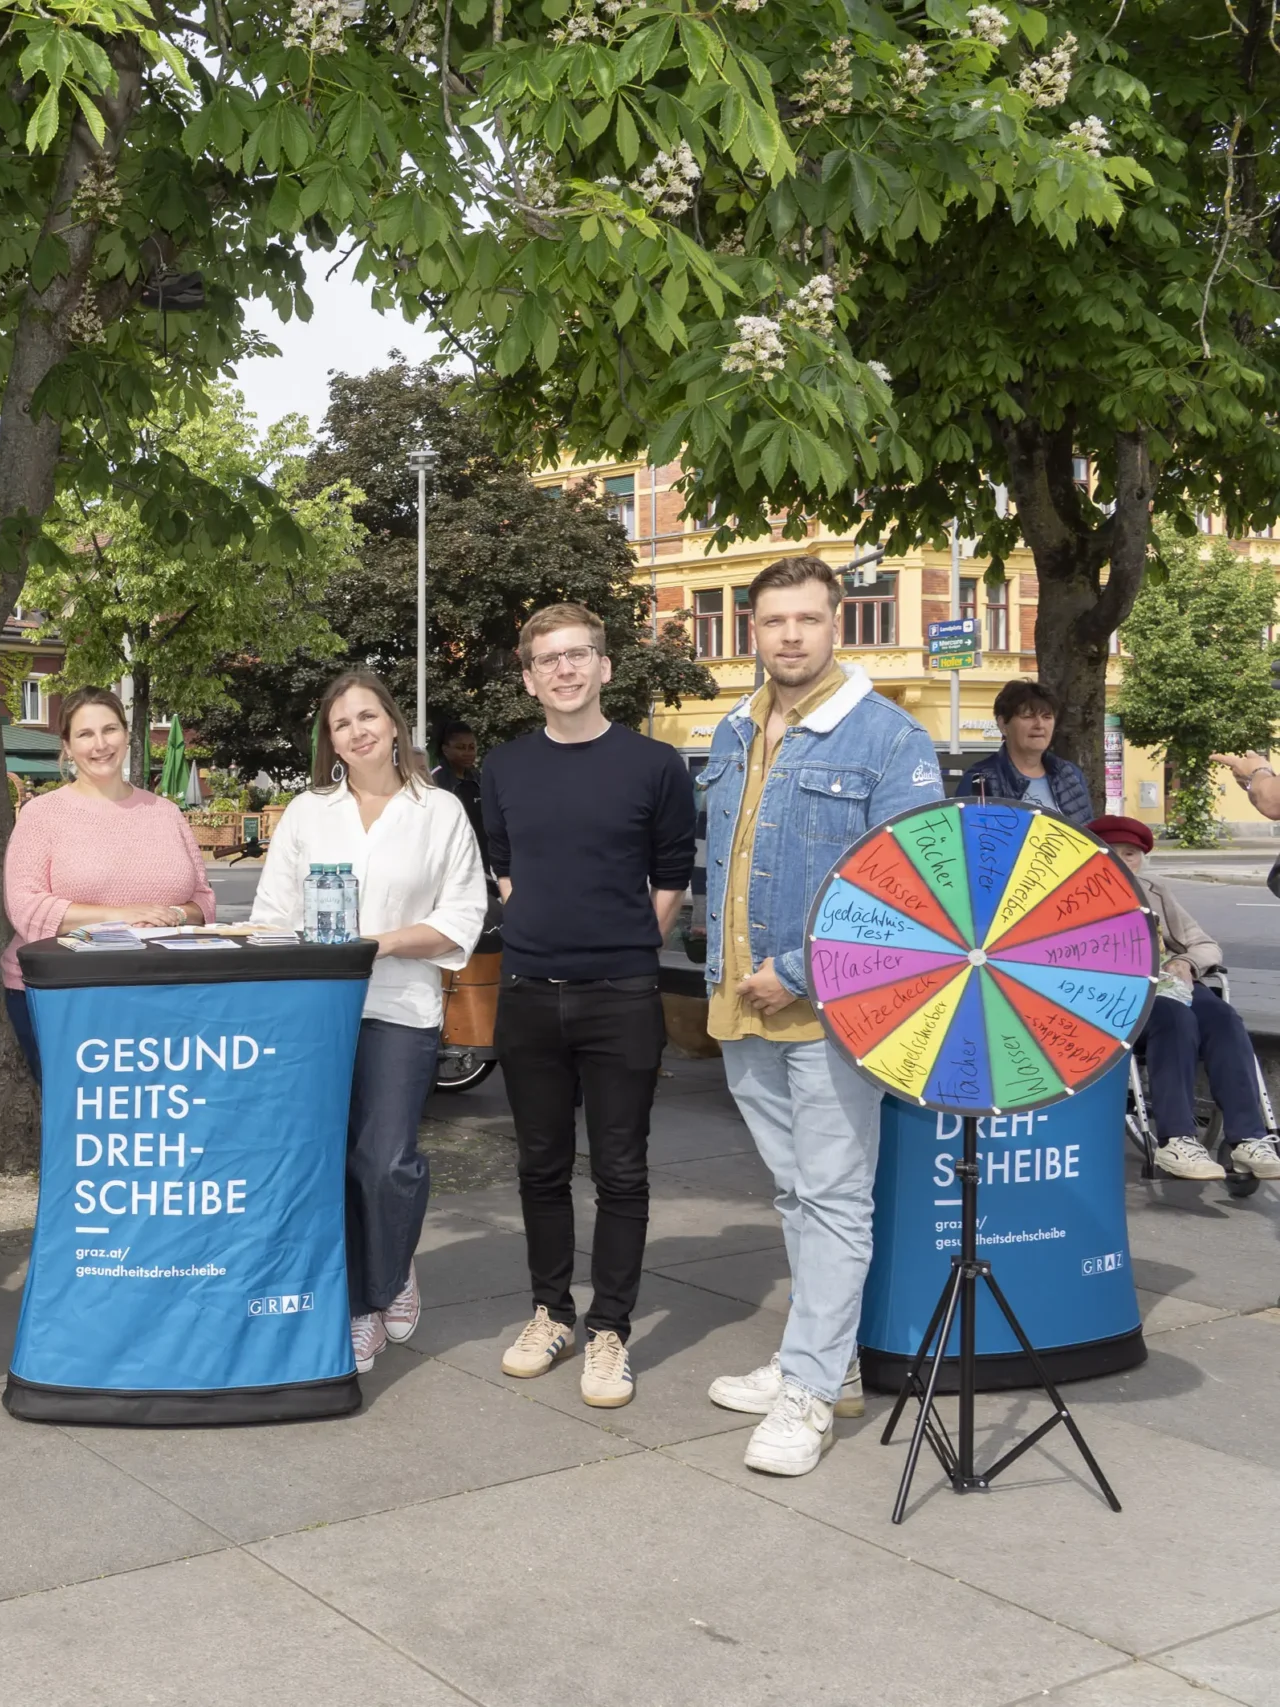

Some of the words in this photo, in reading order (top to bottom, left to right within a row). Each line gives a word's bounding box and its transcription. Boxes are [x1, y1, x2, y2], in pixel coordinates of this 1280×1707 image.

[909, 812, 957, 888] Fächer
[969, 804, 1020, 895] Pflaster
[857, 844, 929, 911] Wasser
[1001, 823, 1088, 923] Kugelschreiber
[1056, 867, 1131, 921] Wasser
[851, 926, 894, 941] Test
[1045, 926, 1145, 966] Hitzecheck
[812, 950, 904, 992] Pflaster
[832, 976, 937, 1047] Hitzecheck
[1046, 1013, 1078, 1038] Test
[75, 1035, 276, 1073] GESUND-
[1001, 1034, 1048, 1103] Wasser
[75, 1084, 206, 1120] HEITS-
[75, 1132, 204, 1167] DREH-
[933, 1144, 1080, 1187] SHEIBE
[74, 1179, 247, 1216] SCHEIBE
[75, 1247, 131, 1261] graz.at/
[75, 1265, 227, 1278] gesundheitsdrehscheibe
[1083, 1253, 1122, 1274] GRAZ
[249, 1293, 312, 1316] GRAZ
